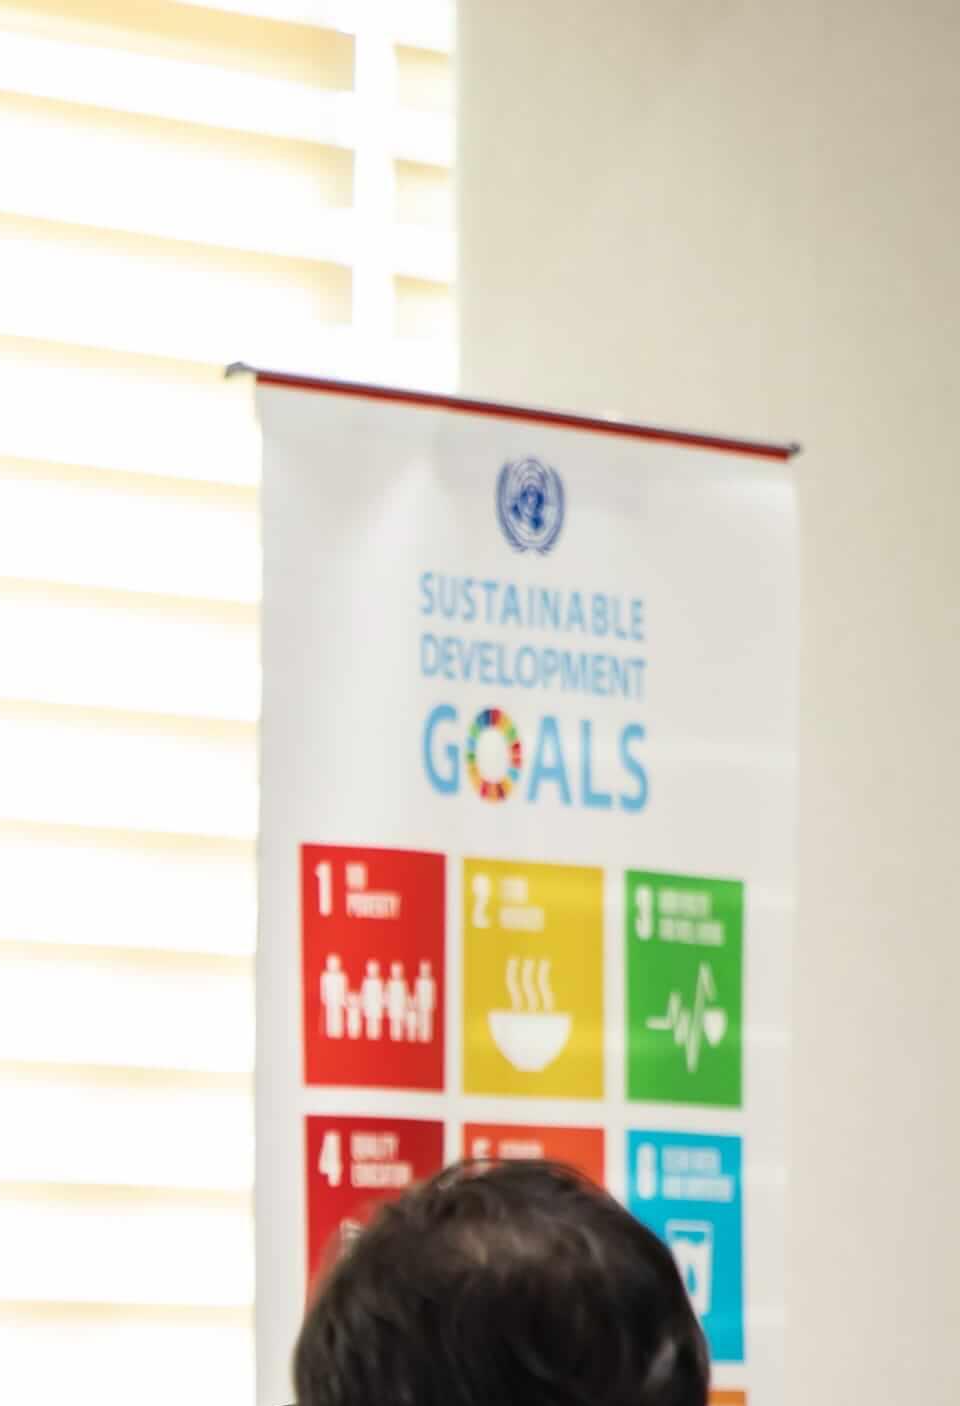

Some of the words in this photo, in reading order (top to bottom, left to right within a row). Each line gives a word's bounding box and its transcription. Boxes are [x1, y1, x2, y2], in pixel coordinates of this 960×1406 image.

[419, 571, 645, 641] SUSTAINABLE
[419, 633, 646, 699] DEVELOPMENT
[422, 704, 648, 812] GOALS
[314, 861, 332, 917] 1
[472, 874, 491, 929] 2
[635, 884, 653, 941] 3
[318, 1131, 342, 1187] 4
